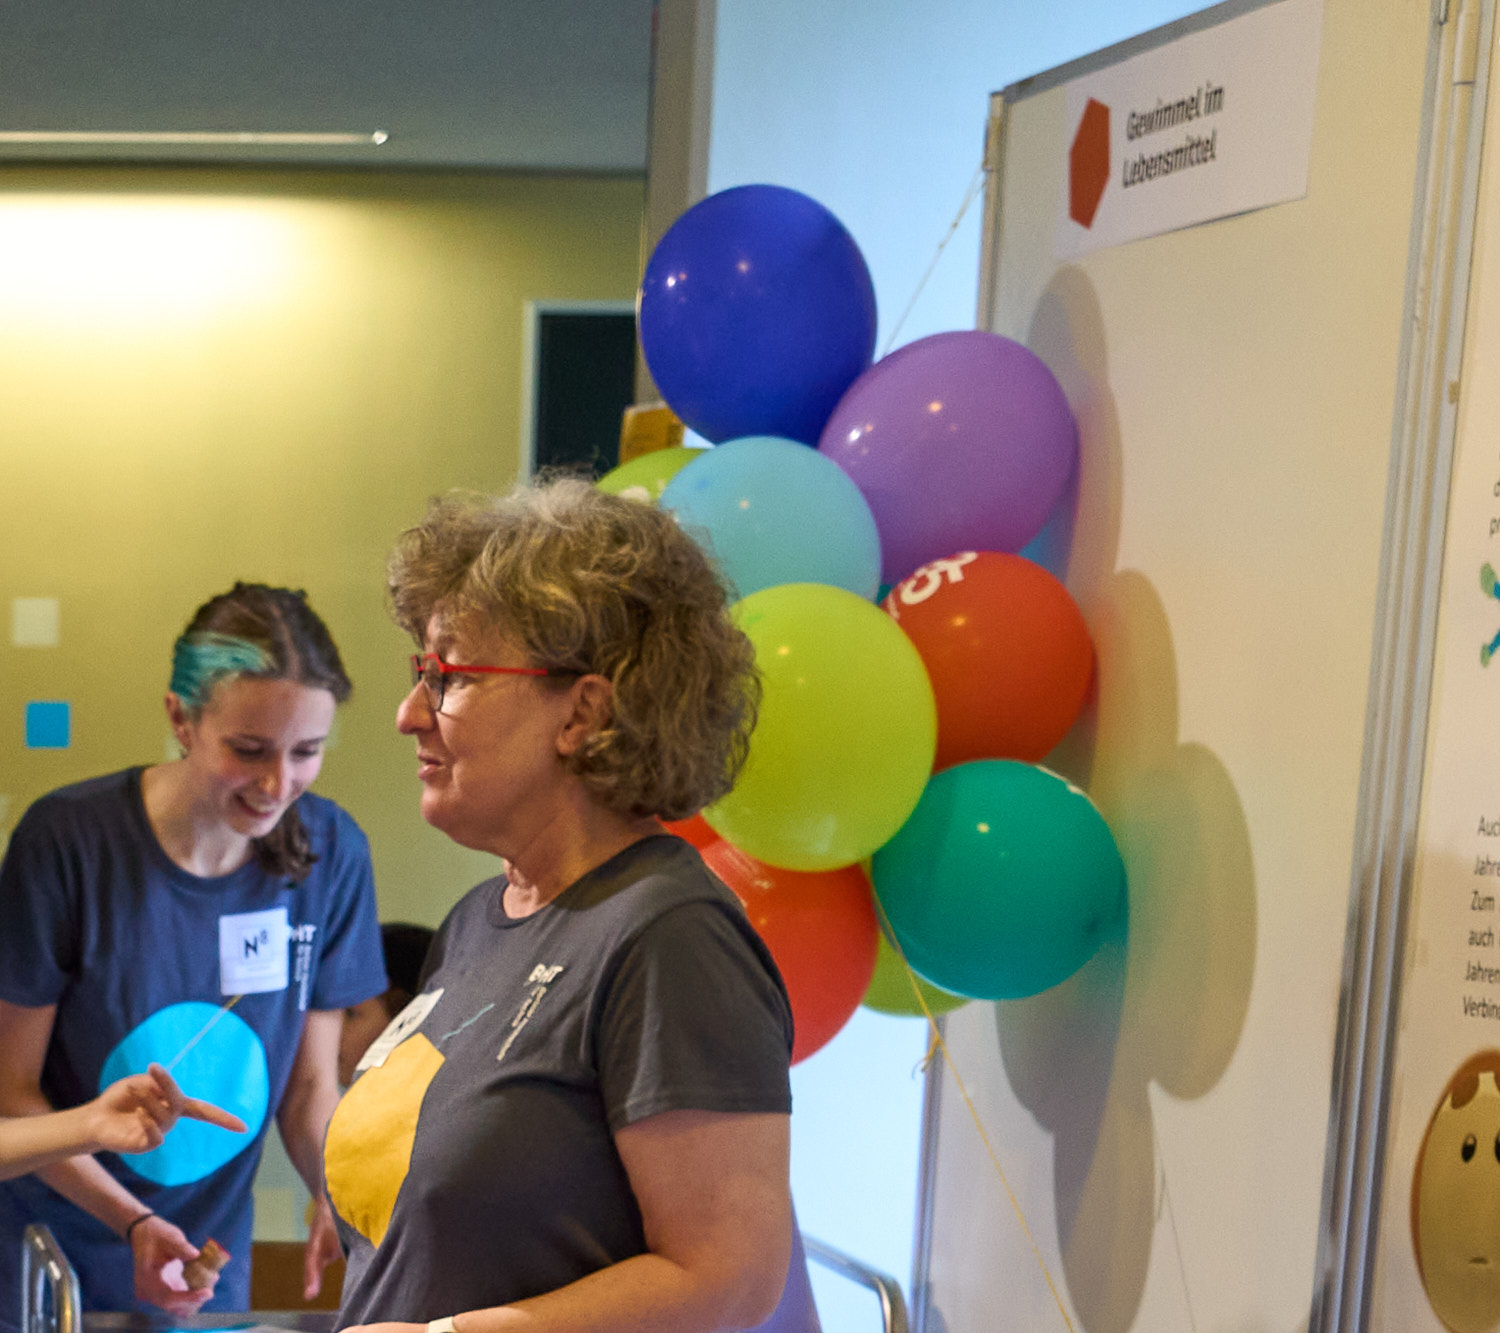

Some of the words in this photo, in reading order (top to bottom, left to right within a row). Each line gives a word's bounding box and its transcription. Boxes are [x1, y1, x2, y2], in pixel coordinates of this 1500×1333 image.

[1127, 87, 1202, 141] Gewimmel
[1122, 127, 1217, 189] Lebensmittel
[1471, 890, 1495, 911] Zum
[1468, 927, 1494, 948] auch
[1466, 960, 1500, 984] Jahren
